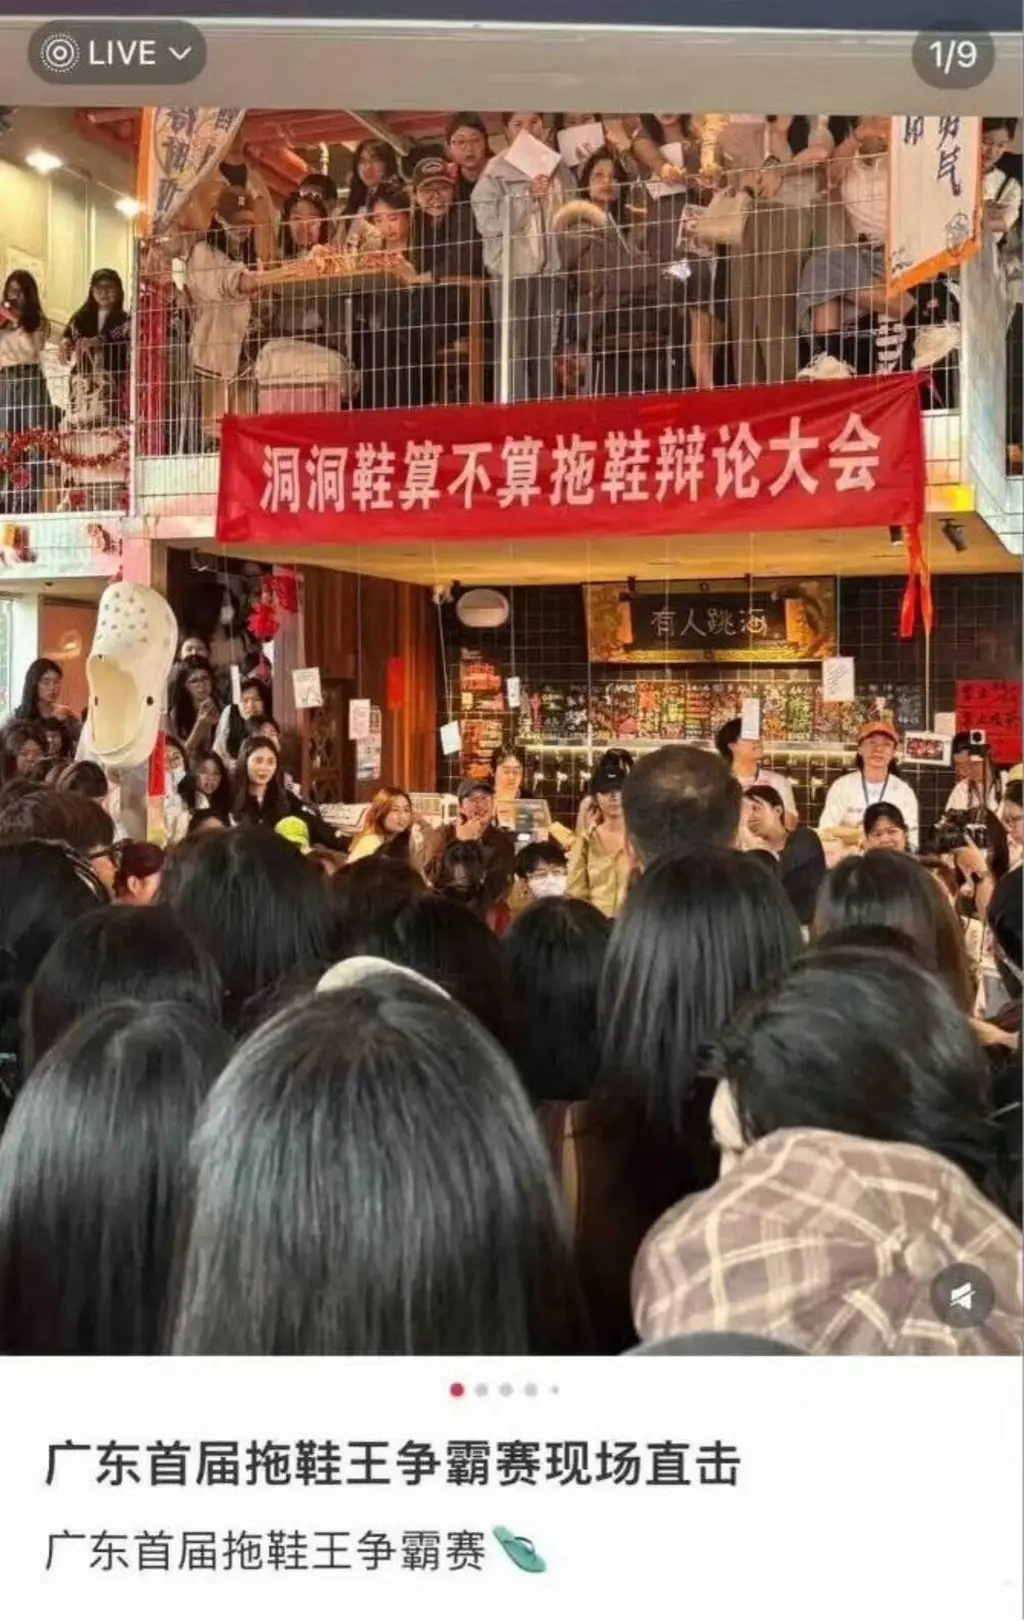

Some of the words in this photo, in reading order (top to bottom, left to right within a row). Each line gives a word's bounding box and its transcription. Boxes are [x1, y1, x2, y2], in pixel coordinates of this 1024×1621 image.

[259, 412, 882, 513] 洞洞鞋算不算拖鞋辩论大会
[651, 606, 768, 637] 有人跳海
